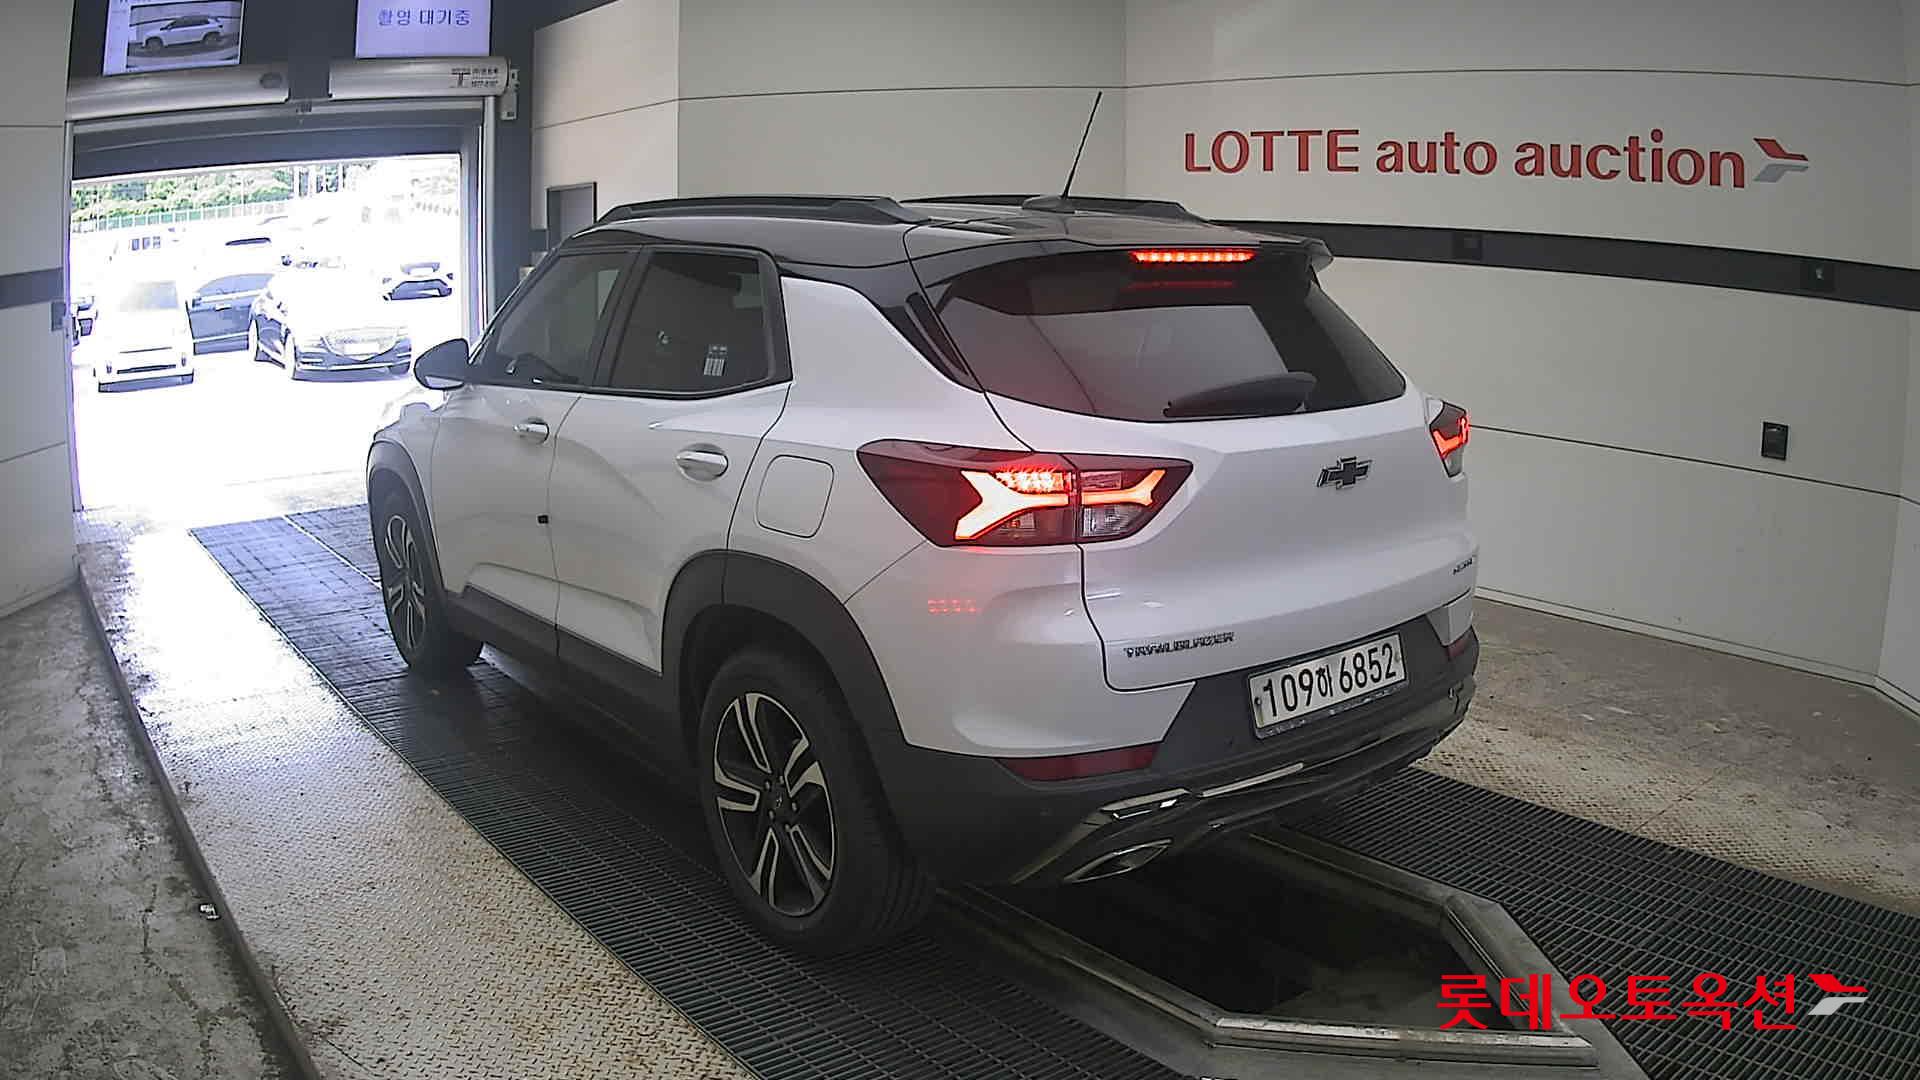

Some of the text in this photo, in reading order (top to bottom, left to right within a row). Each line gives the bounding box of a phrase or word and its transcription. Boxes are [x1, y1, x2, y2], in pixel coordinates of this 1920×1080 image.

[419, 9, 471, 26] 대기중
[1184, 128, 1746, 188] LOTTE auto auction
[1339, 642, 1397, 693] 6852
